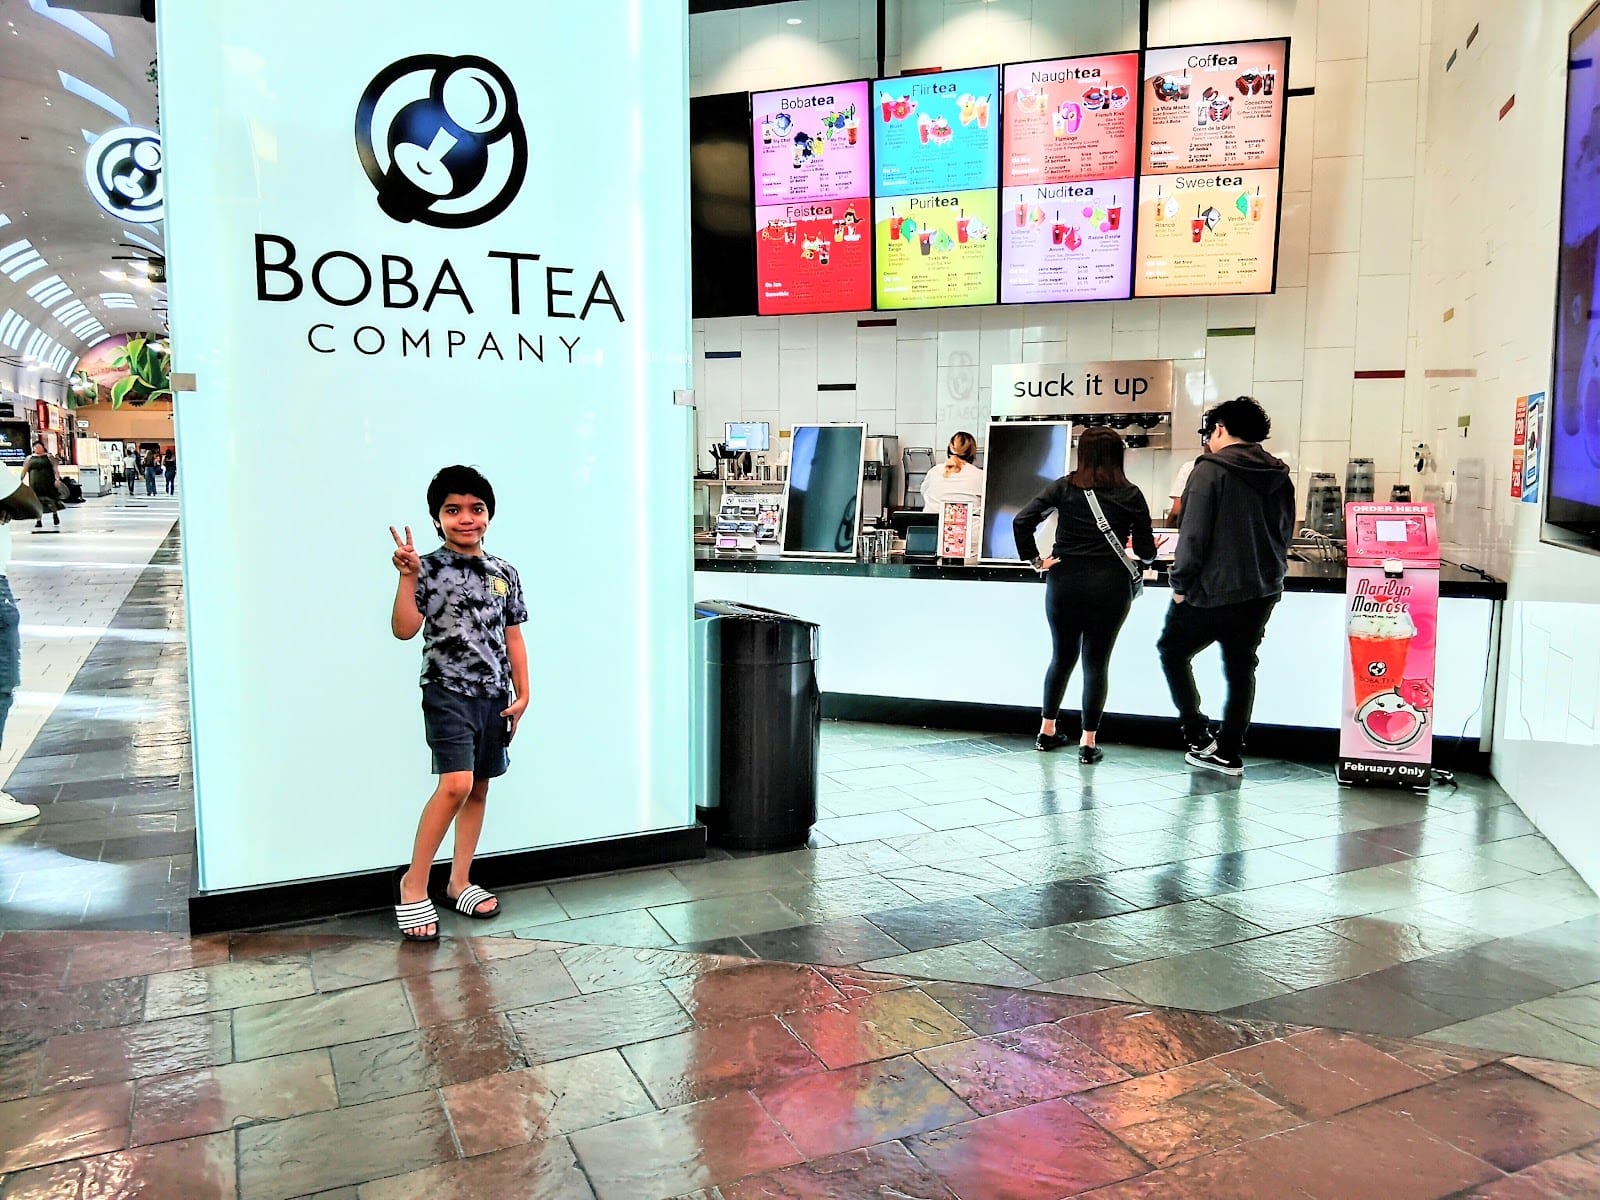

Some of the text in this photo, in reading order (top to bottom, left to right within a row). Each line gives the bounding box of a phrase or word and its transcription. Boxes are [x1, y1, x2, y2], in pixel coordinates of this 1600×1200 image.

[1188, 54, 1238, 68] Coffea
[1031, 67, 1101, 83] Naughtea
[913, 83, 957, 96] Flirtea
[781, 95, 835, 110] Bobatea
[1175, 176, 1243, 190] Sweetea
[1037, 186, 1094, 200] Nuditea
[910, 196, 959, 210] Puritea
[786, 205, 832, 217] Feistea
[254, 233, 625, 323] BOBA TEA
[307, 323, 581, 363] COMPANY
[1014, 373, 1148, 401] suck it up
[1356, 578, 1411, 603] Marilyn
[1351, 596, 1409, 613] Monrose
[1360, 675, 1379, 684] BOBA
[1344, 762, 1425, 778] February Only
